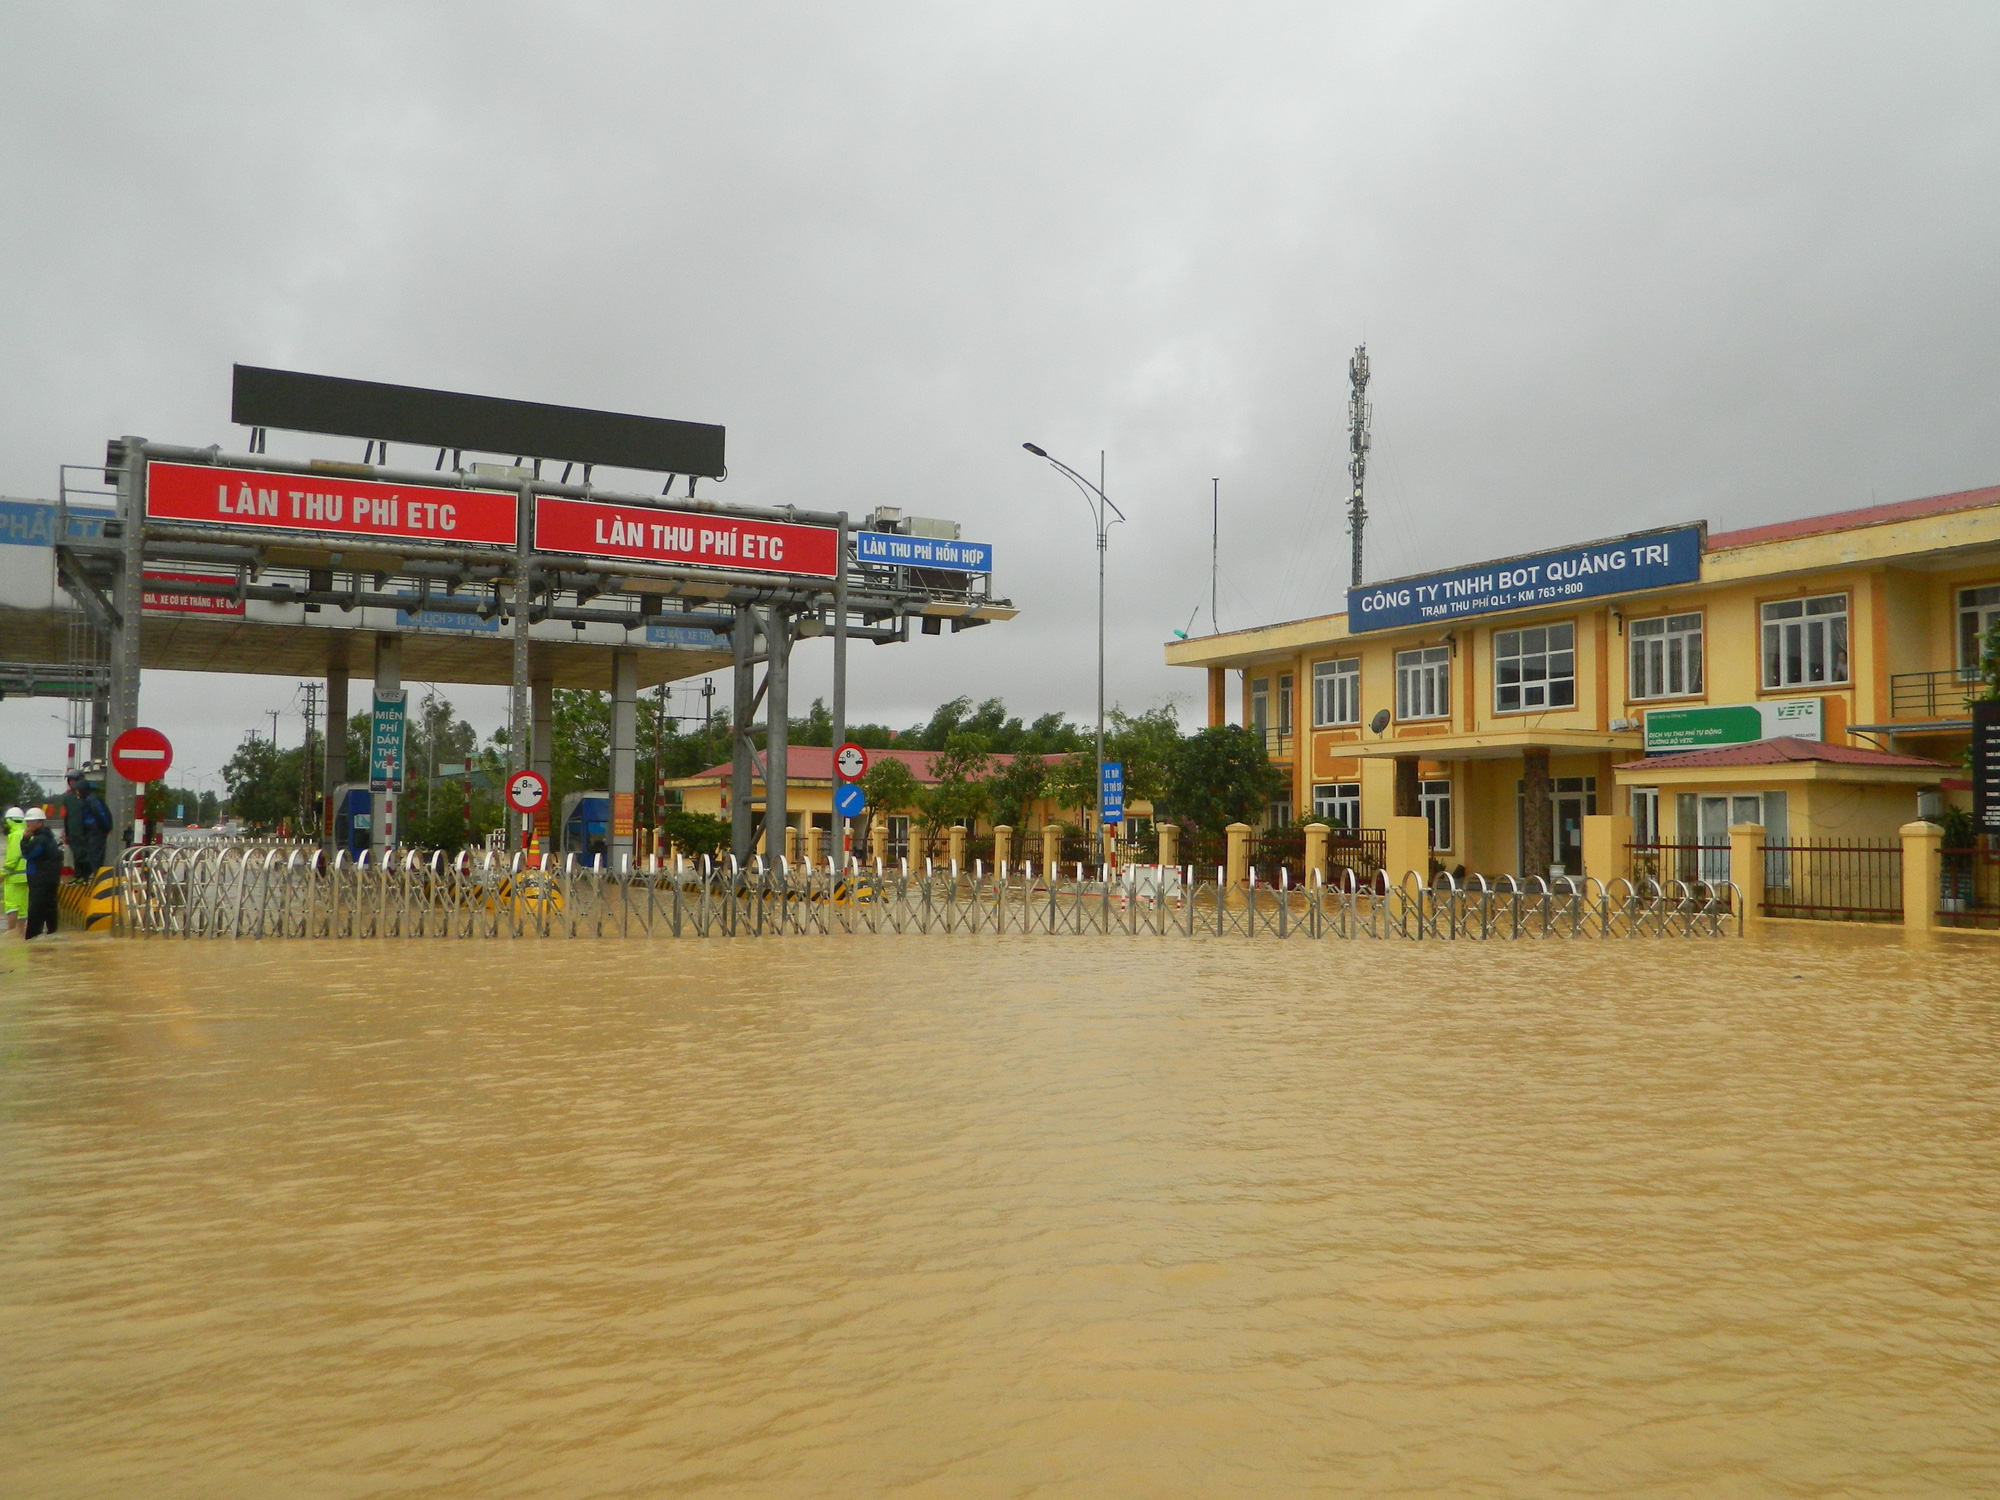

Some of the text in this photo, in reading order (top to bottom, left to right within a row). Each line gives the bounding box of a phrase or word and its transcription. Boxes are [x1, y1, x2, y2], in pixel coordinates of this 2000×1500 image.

[218, 481, 456, 531] LÀN THU PHÍ ETC
[595, 515, 784, 561] LÀN THU PHÍ ETC
[863, 537, 984, 567] LÀN THU PHÍ HỖN HỢP
[1361, 543, 1669, 613] CÔNG TY TNHH BOT QUẢNG TRỊ
[160, 594, 169, 605] XE
[1421, 603, 1447, 617] TRẠM
[1450, 600, 1469, 613] THU
[1472, 594, 1489, 609] PHÍ
[1777, 704, 1815, 717] VETC
[379, 721, 398, 733] PHÍ
[377, 734, 399, 745] DÁN
[374, 761, 400, 769] VEC
